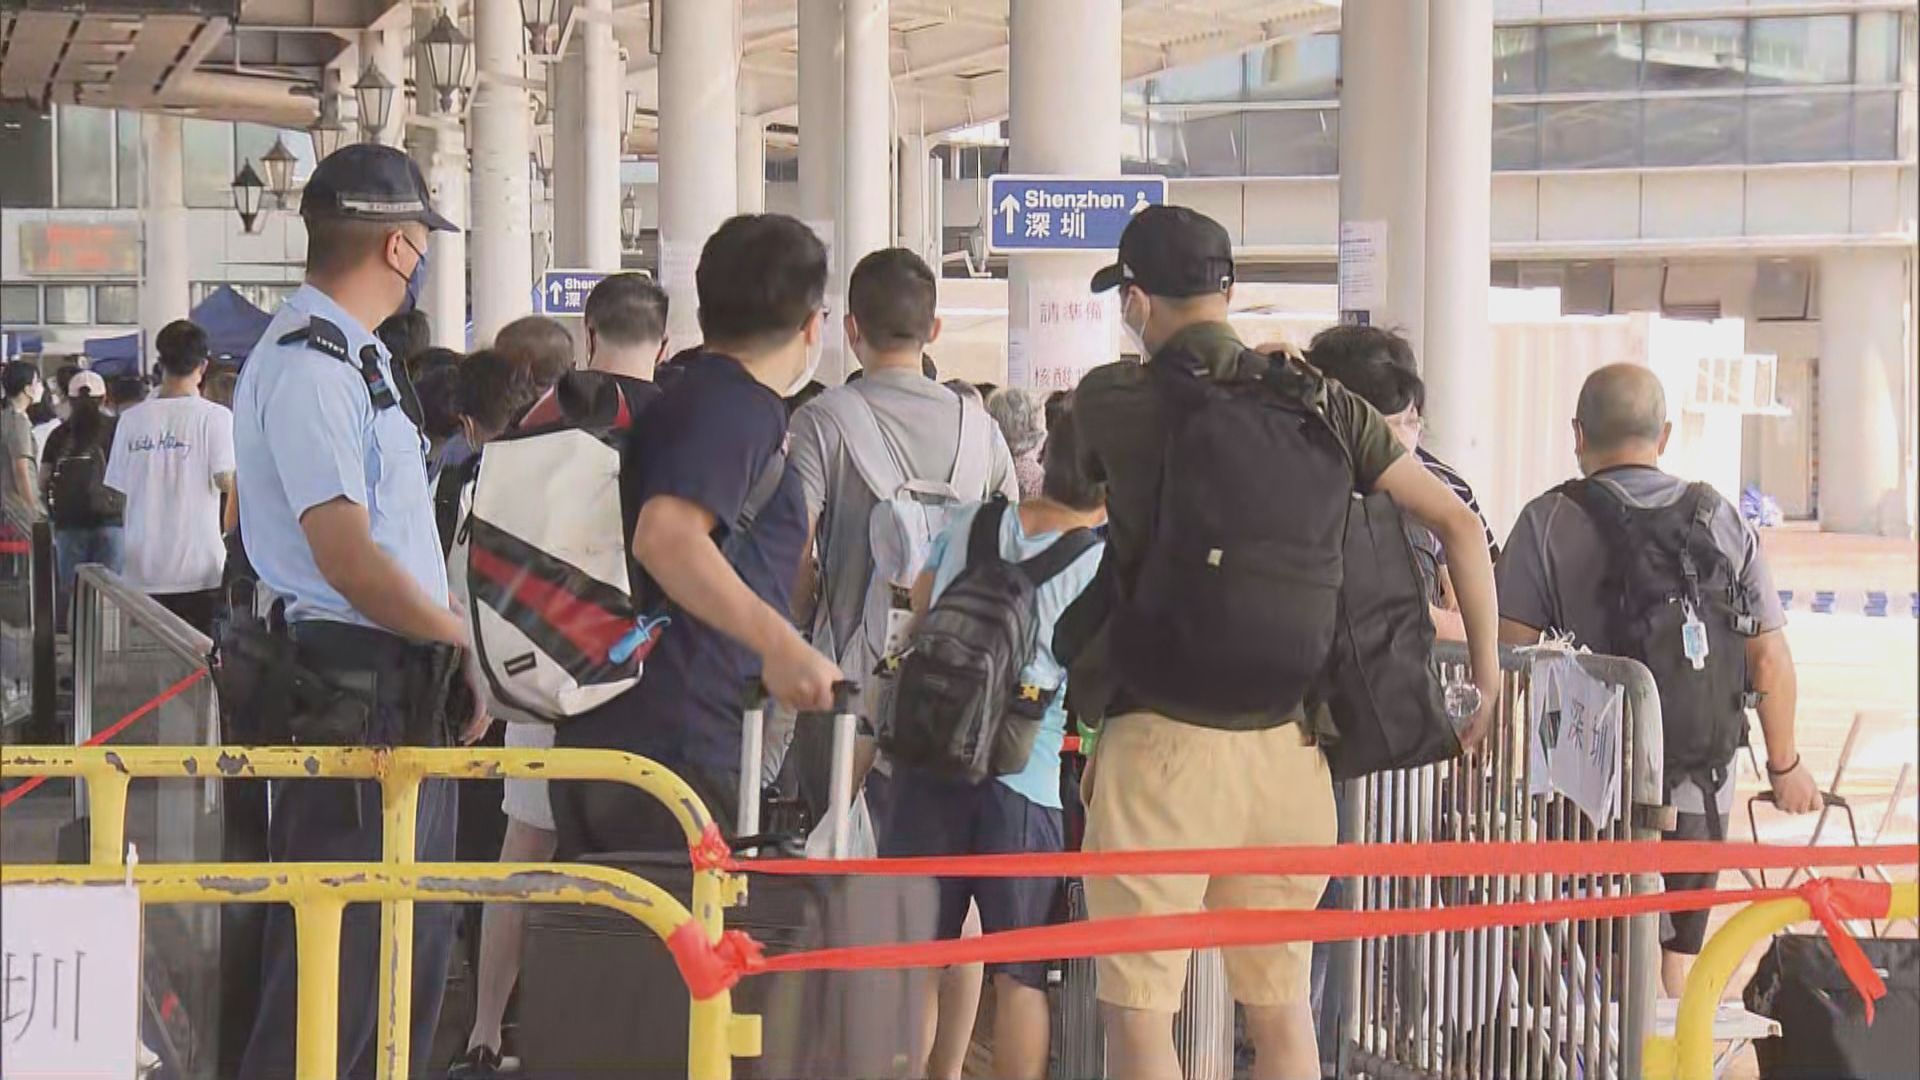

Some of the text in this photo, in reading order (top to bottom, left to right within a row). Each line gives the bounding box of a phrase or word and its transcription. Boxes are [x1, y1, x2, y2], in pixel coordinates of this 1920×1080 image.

[1025, 189, 1125, 209] Shenzhen
[1025, 211, 1086, 239] 深圳
[565, 277, 600, 289] Shen
[565, 291, 590, 307] 深
[1568, 702, 1609, 768] 深圳
